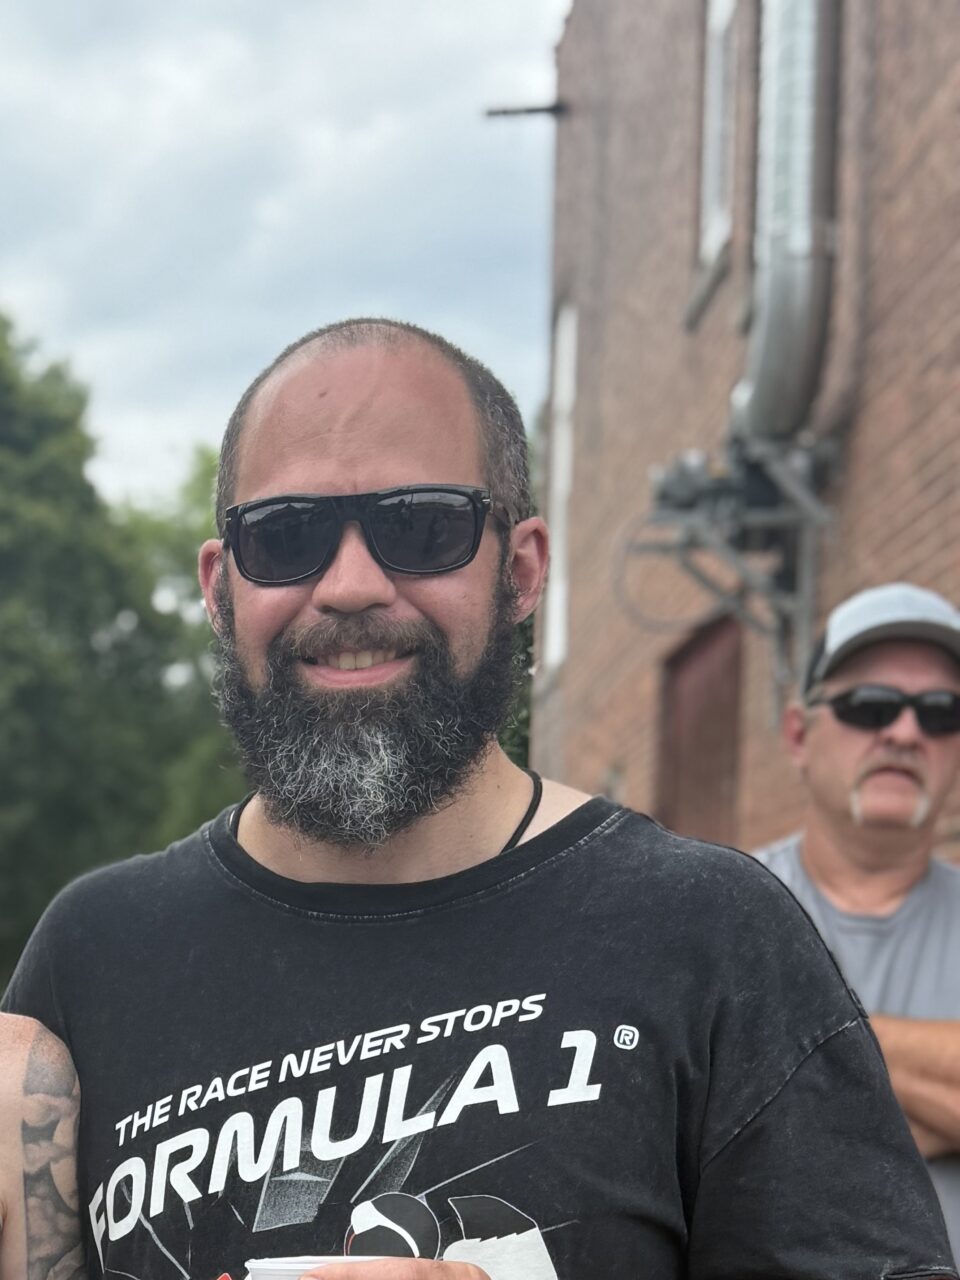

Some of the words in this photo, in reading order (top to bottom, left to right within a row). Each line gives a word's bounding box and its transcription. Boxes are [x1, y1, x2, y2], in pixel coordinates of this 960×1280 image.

[88, 1043, 520, 1271] FORMULA
[115, 1094, 173, 1147] THE
[178, 1060, 273, 1117] RACE
[278, 1023, 411, 1083] NEVER
[416, 993, 547, 1044] STOPS
